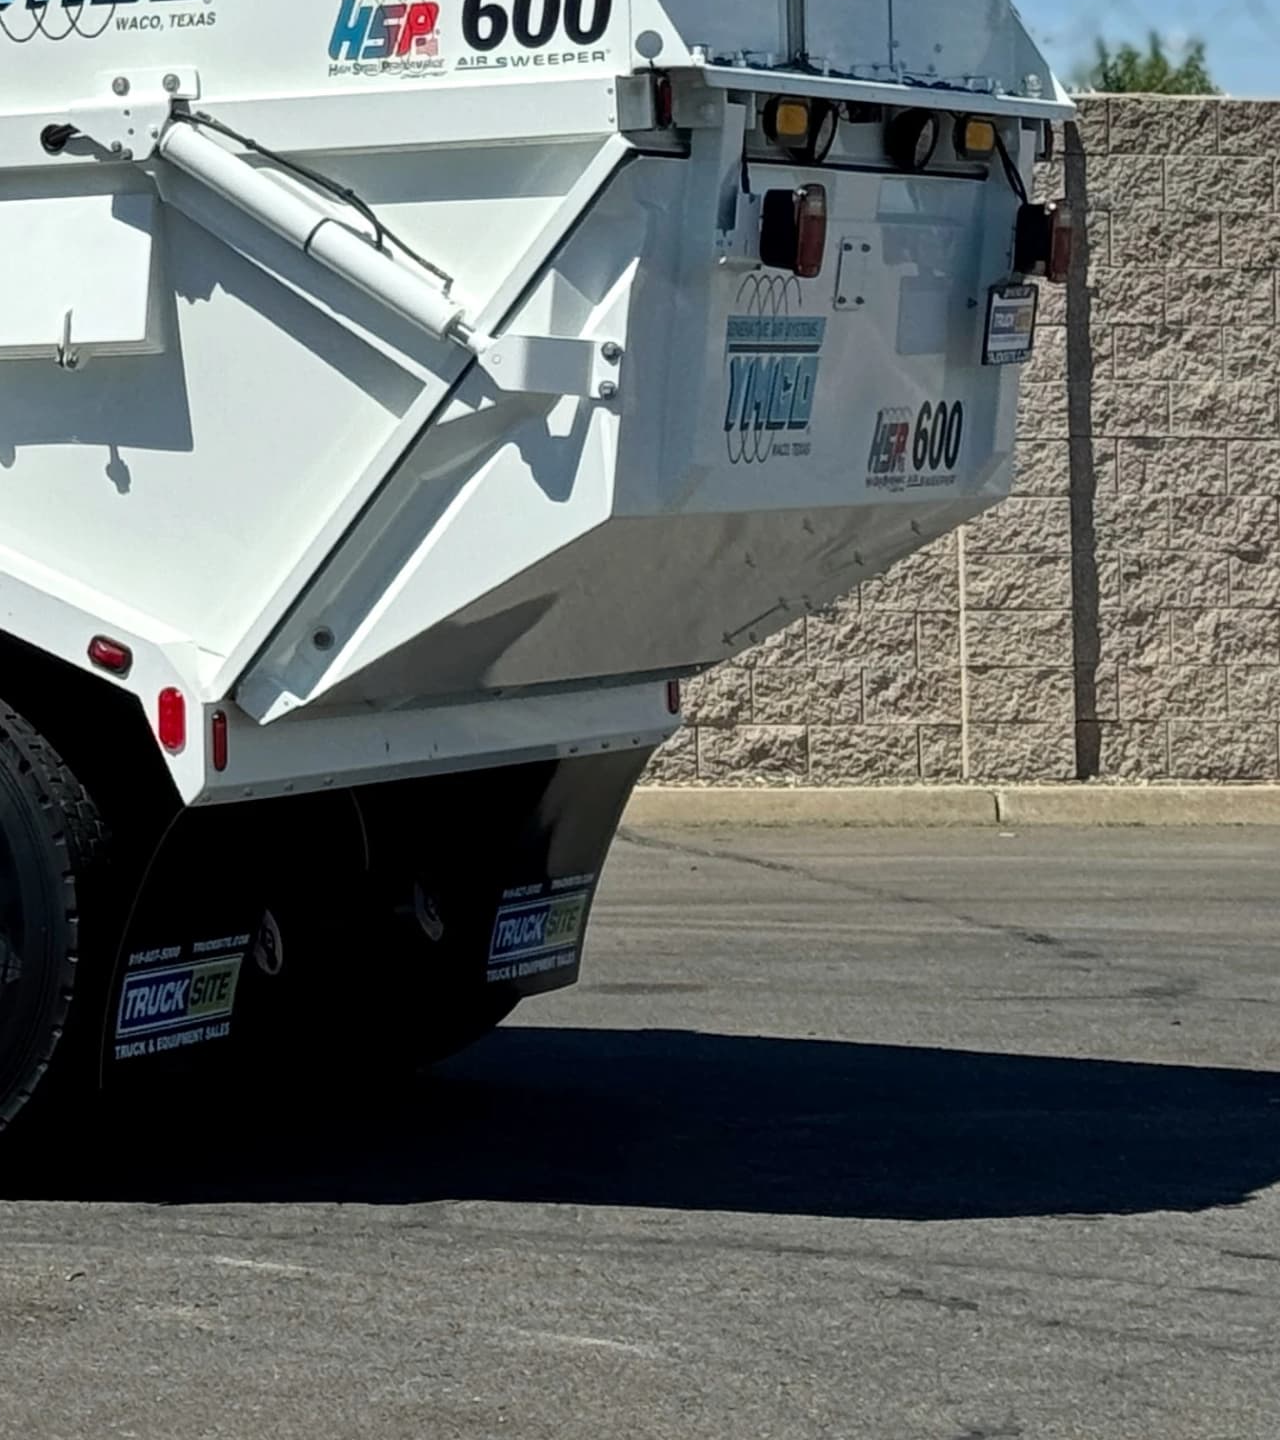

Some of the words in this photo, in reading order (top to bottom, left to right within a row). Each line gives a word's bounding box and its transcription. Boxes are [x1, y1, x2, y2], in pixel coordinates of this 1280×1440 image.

[115, 14, 164, 32] WACO,
[169, 11, 217, 29] TEXAS
[456, 55, 488, 67] AIR
[495, 51, 606, 68] SWEEPER
[912, 399, 964, 472] 600
[496, 911, 548, 949] TRUCK
[547, 906, 579, 936] SITE
[124, 978, 191, 1021] TRUCK
[190, 972, 232, 1006] SITE
[114, 1041, 146, 1061] TRUCK
[148, 1038, 156, 1054] &
[156, 1027, 204, 1052] EQUIPMENT
[205, 1022, 231, 1040] SALES
